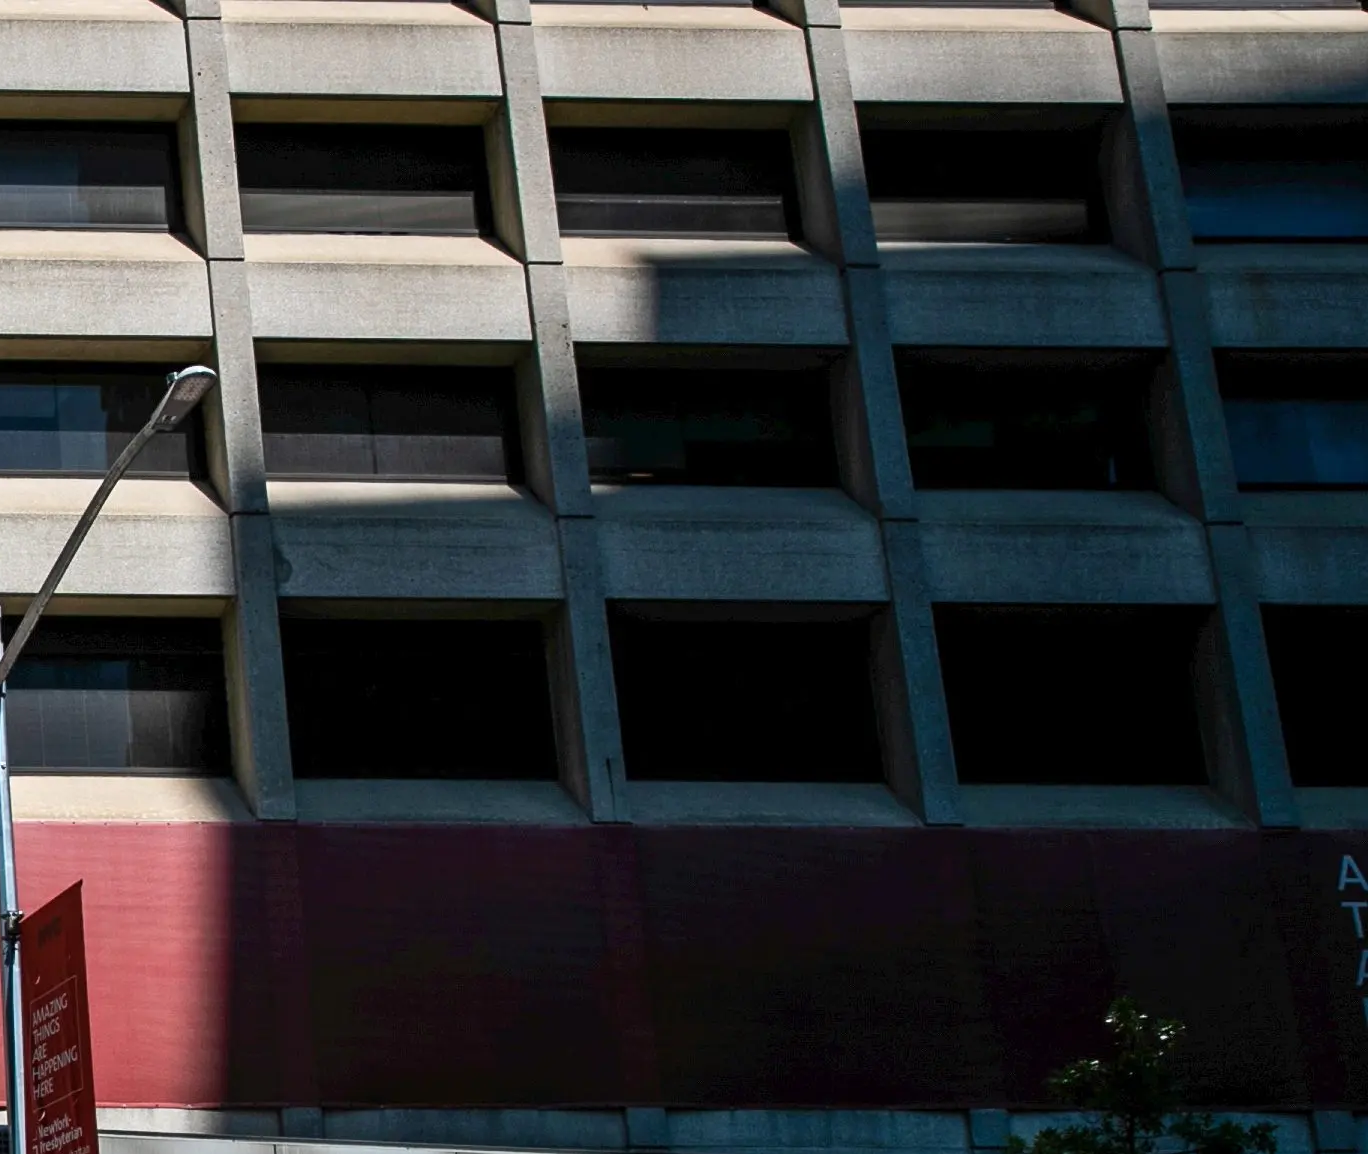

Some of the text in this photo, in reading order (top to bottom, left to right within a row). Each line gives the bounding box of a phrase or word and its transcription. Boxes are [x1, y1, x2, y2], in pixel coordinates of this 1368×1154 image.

[32, 993, 68, 1028] AMAZING
[32, 1016, 61, 1044] THINGS
[32, 1042, 47, 1063] ARE
[32, 1045, 78, 1081] HAPPENING
[33, 1077, 54, 1101] HERE
